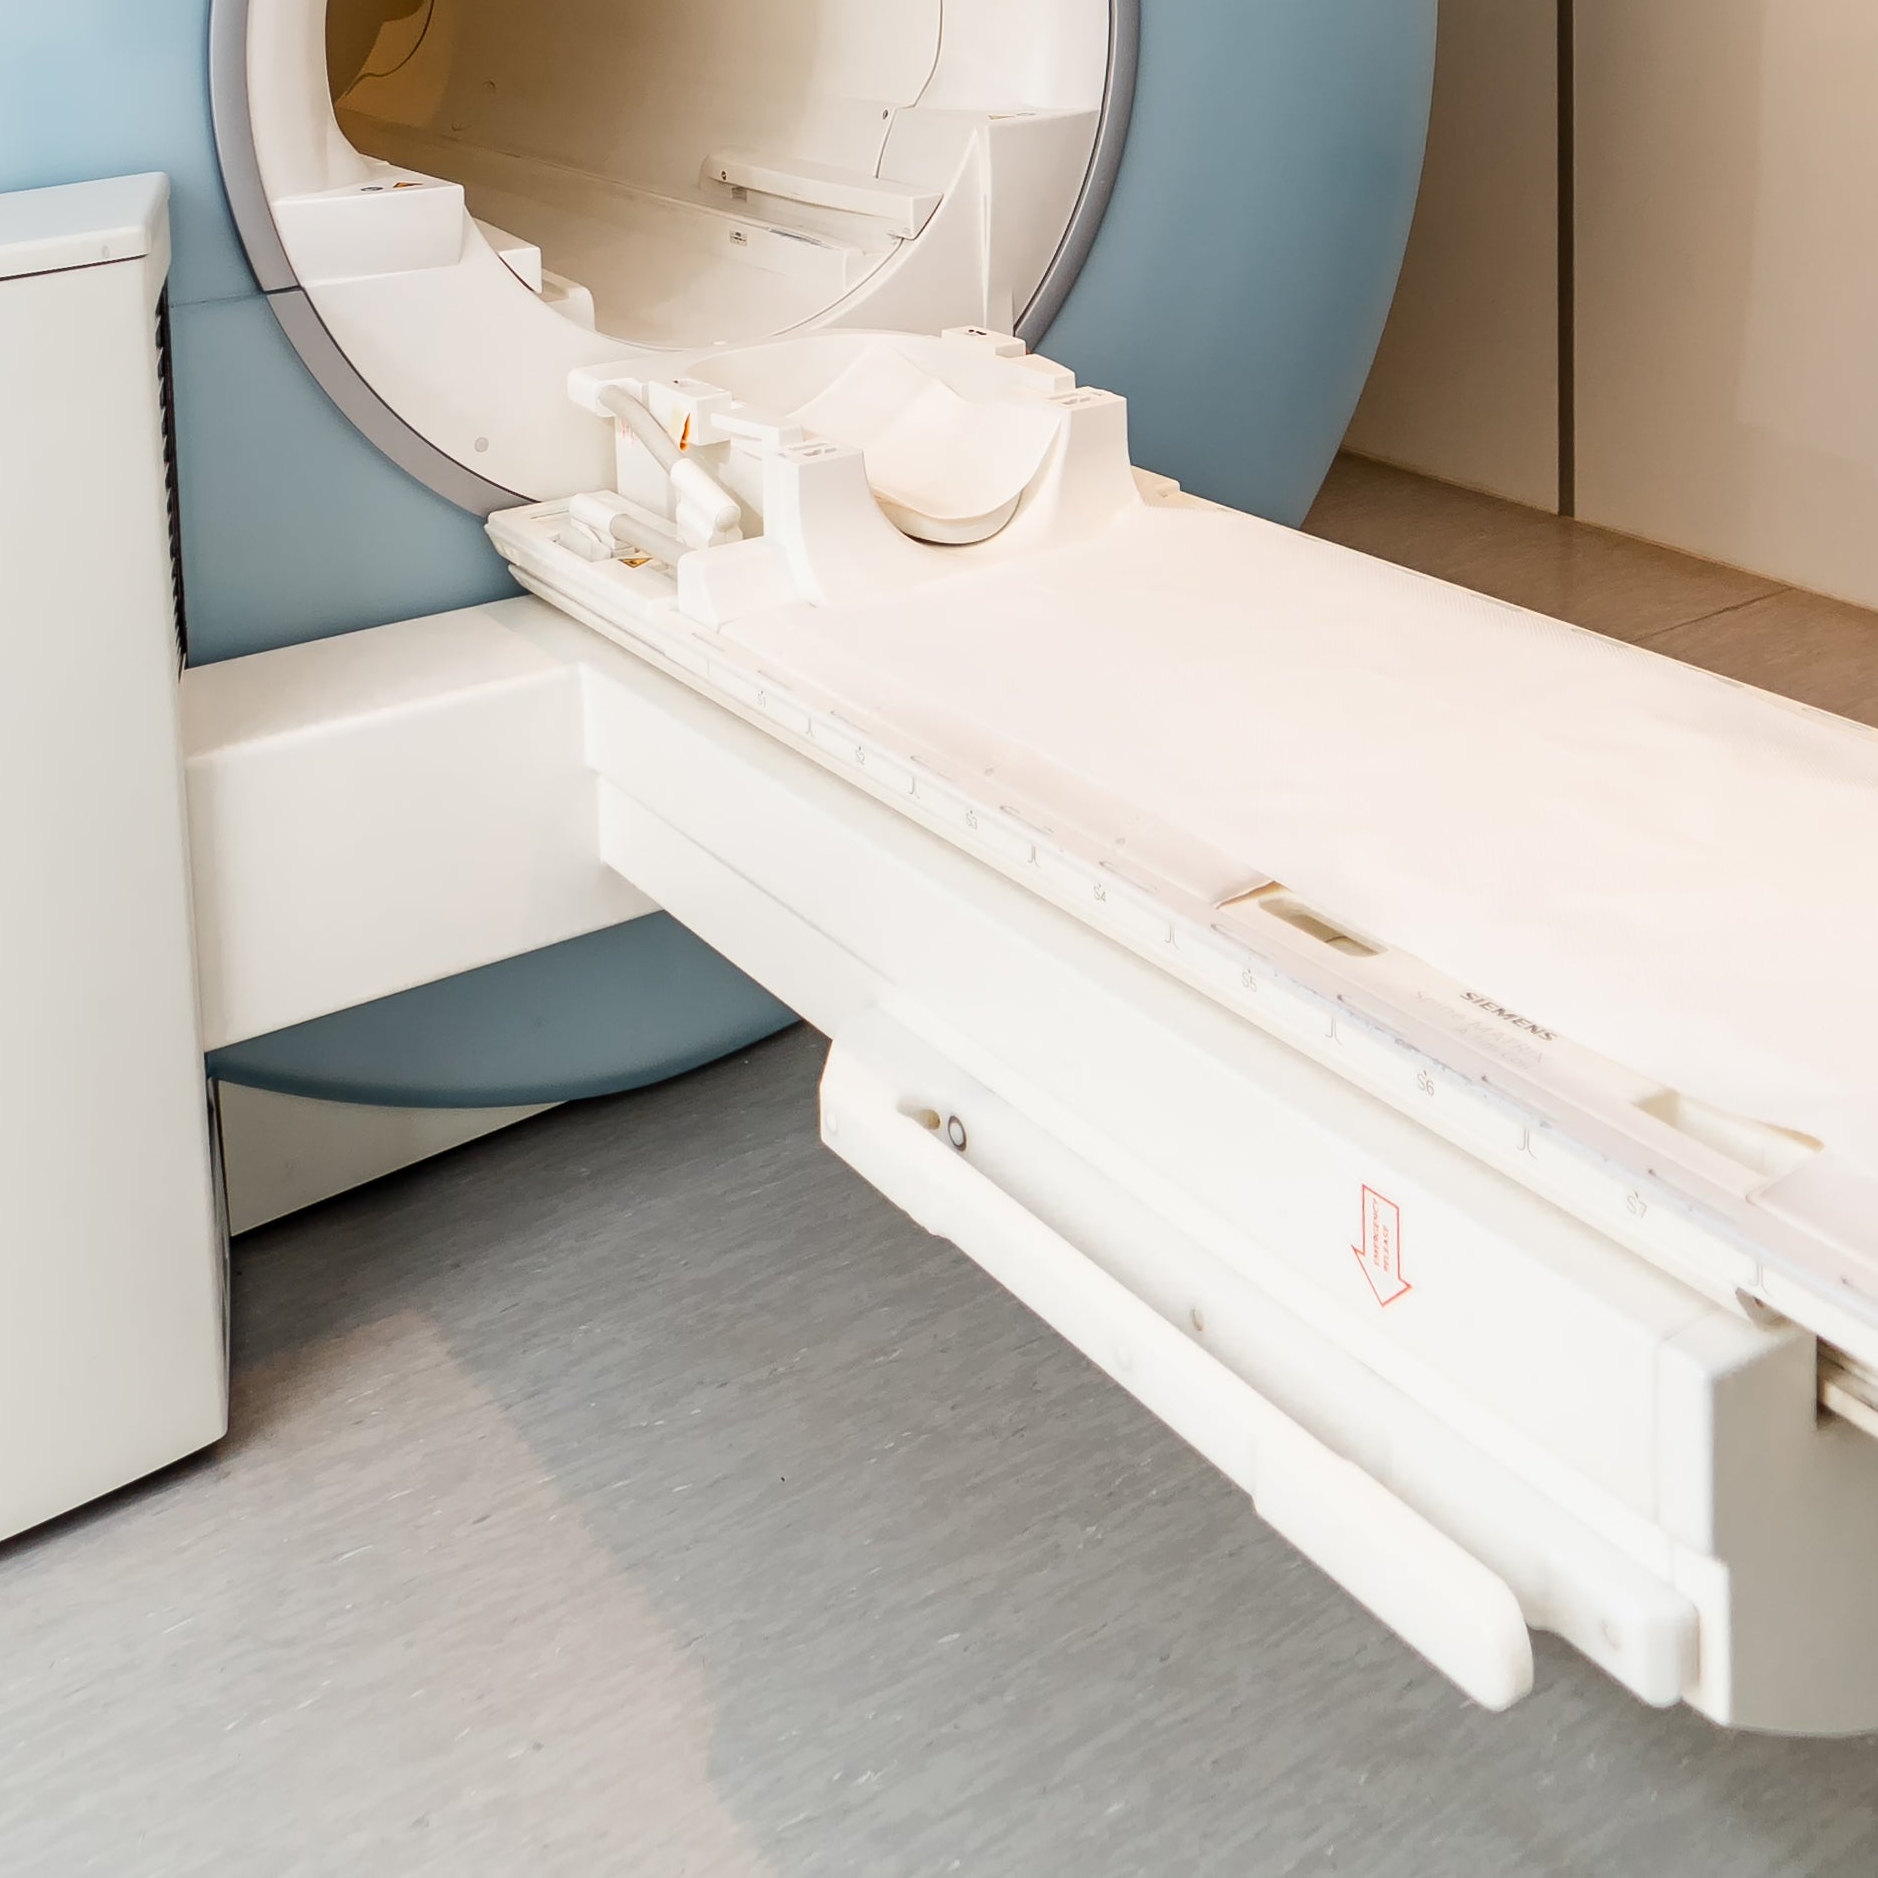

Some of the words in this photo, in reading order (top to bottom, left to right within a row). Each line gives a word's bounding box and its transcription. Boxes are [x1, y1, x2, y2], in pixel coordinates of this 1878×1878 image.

[1241, 971, 1258, 993] S5
[1460, 991, 1558, 1042] SIEMENS
[1417, 1073, 1435, 1097] S6
[1626, 1194, 1648, 1219] S7
[1372, 1197, 1380, 1268] EMERGENCY
[1382, 1225, 1390, 1274] RELEASE
